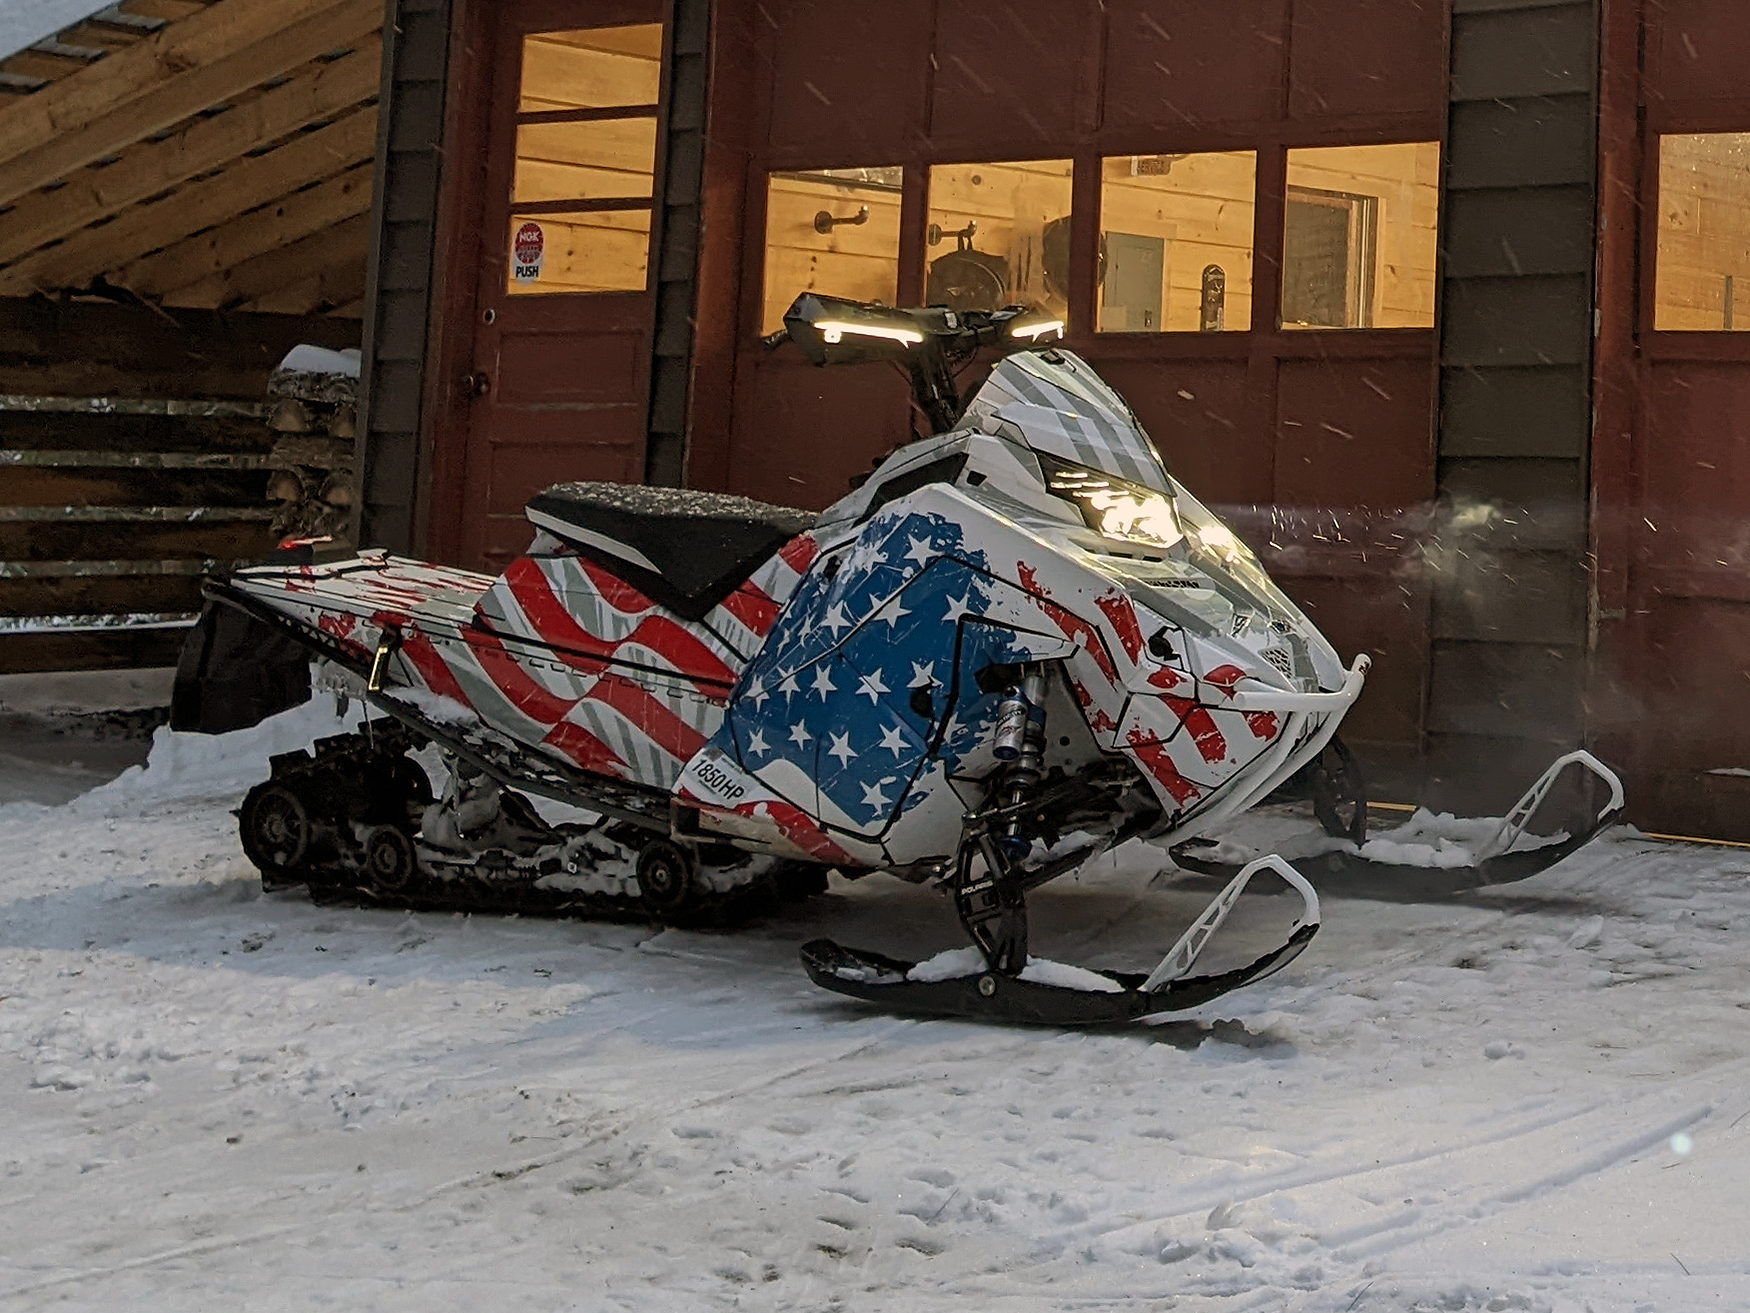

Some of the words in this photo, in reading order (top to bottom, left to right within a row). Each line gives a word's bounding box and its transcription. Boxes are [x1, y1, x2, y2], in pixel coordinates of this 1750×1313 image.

[519, 231, 540, 243] NGK
[515, 265, 540, 278] PUSH
[692, 758, 745, 800] 1850HP
